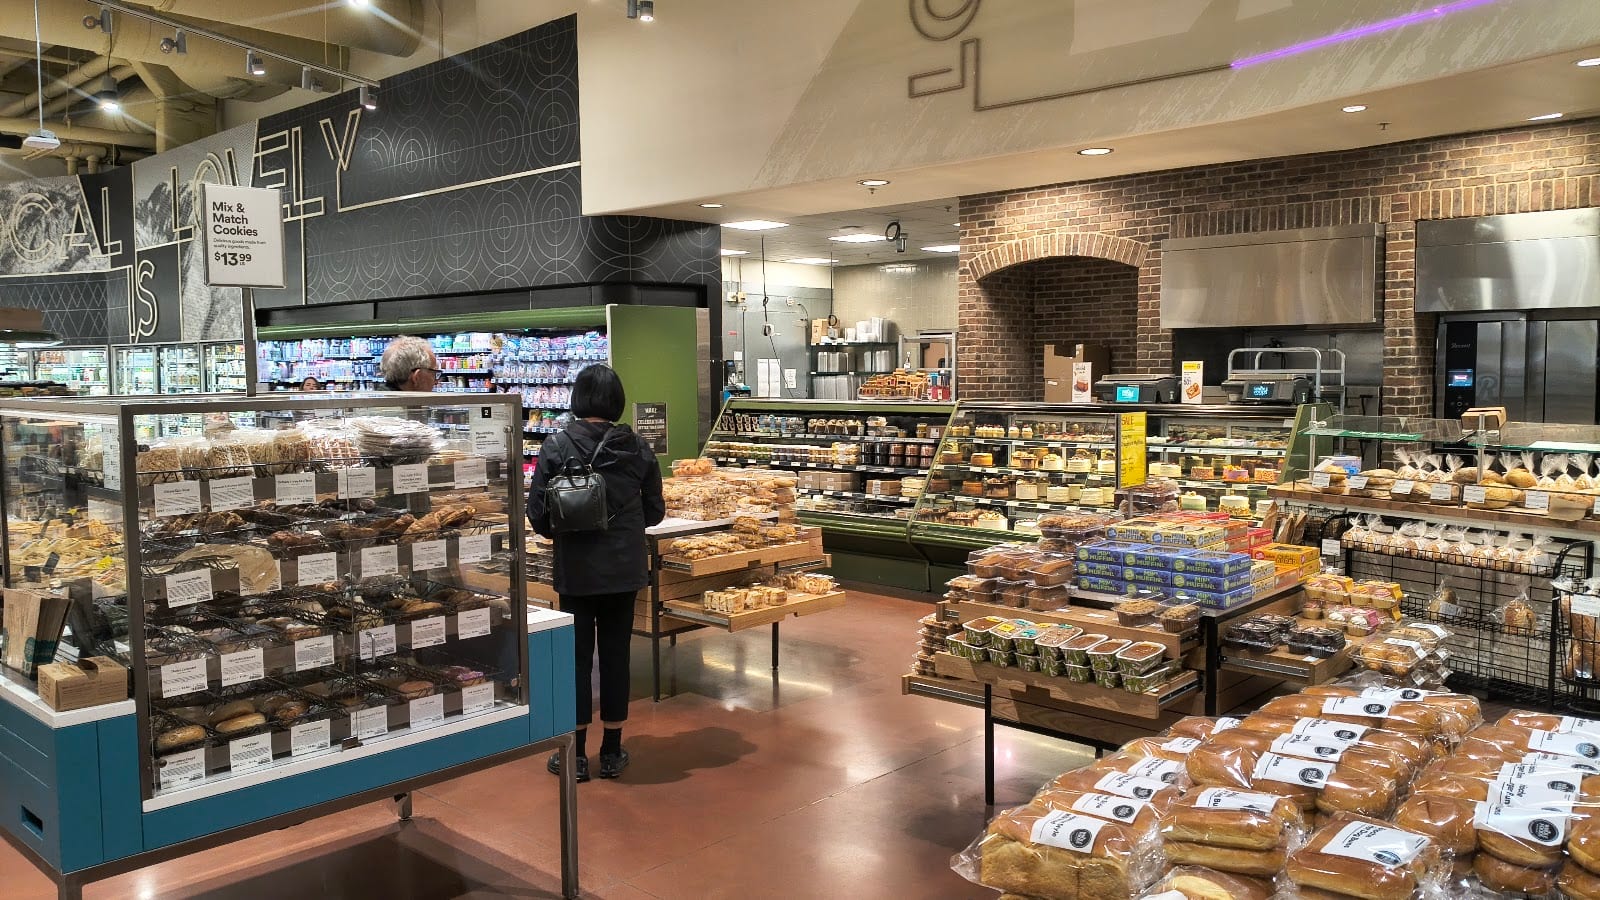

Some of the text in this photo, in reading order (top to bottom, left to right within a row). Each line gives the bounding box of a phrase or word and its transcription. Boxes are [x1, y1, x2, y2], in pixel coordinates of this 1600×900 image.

[212, 201, 245, 214] Mix &
[212, 212, 249, 225] Match
[213, 224, 258, 237] Cookies
